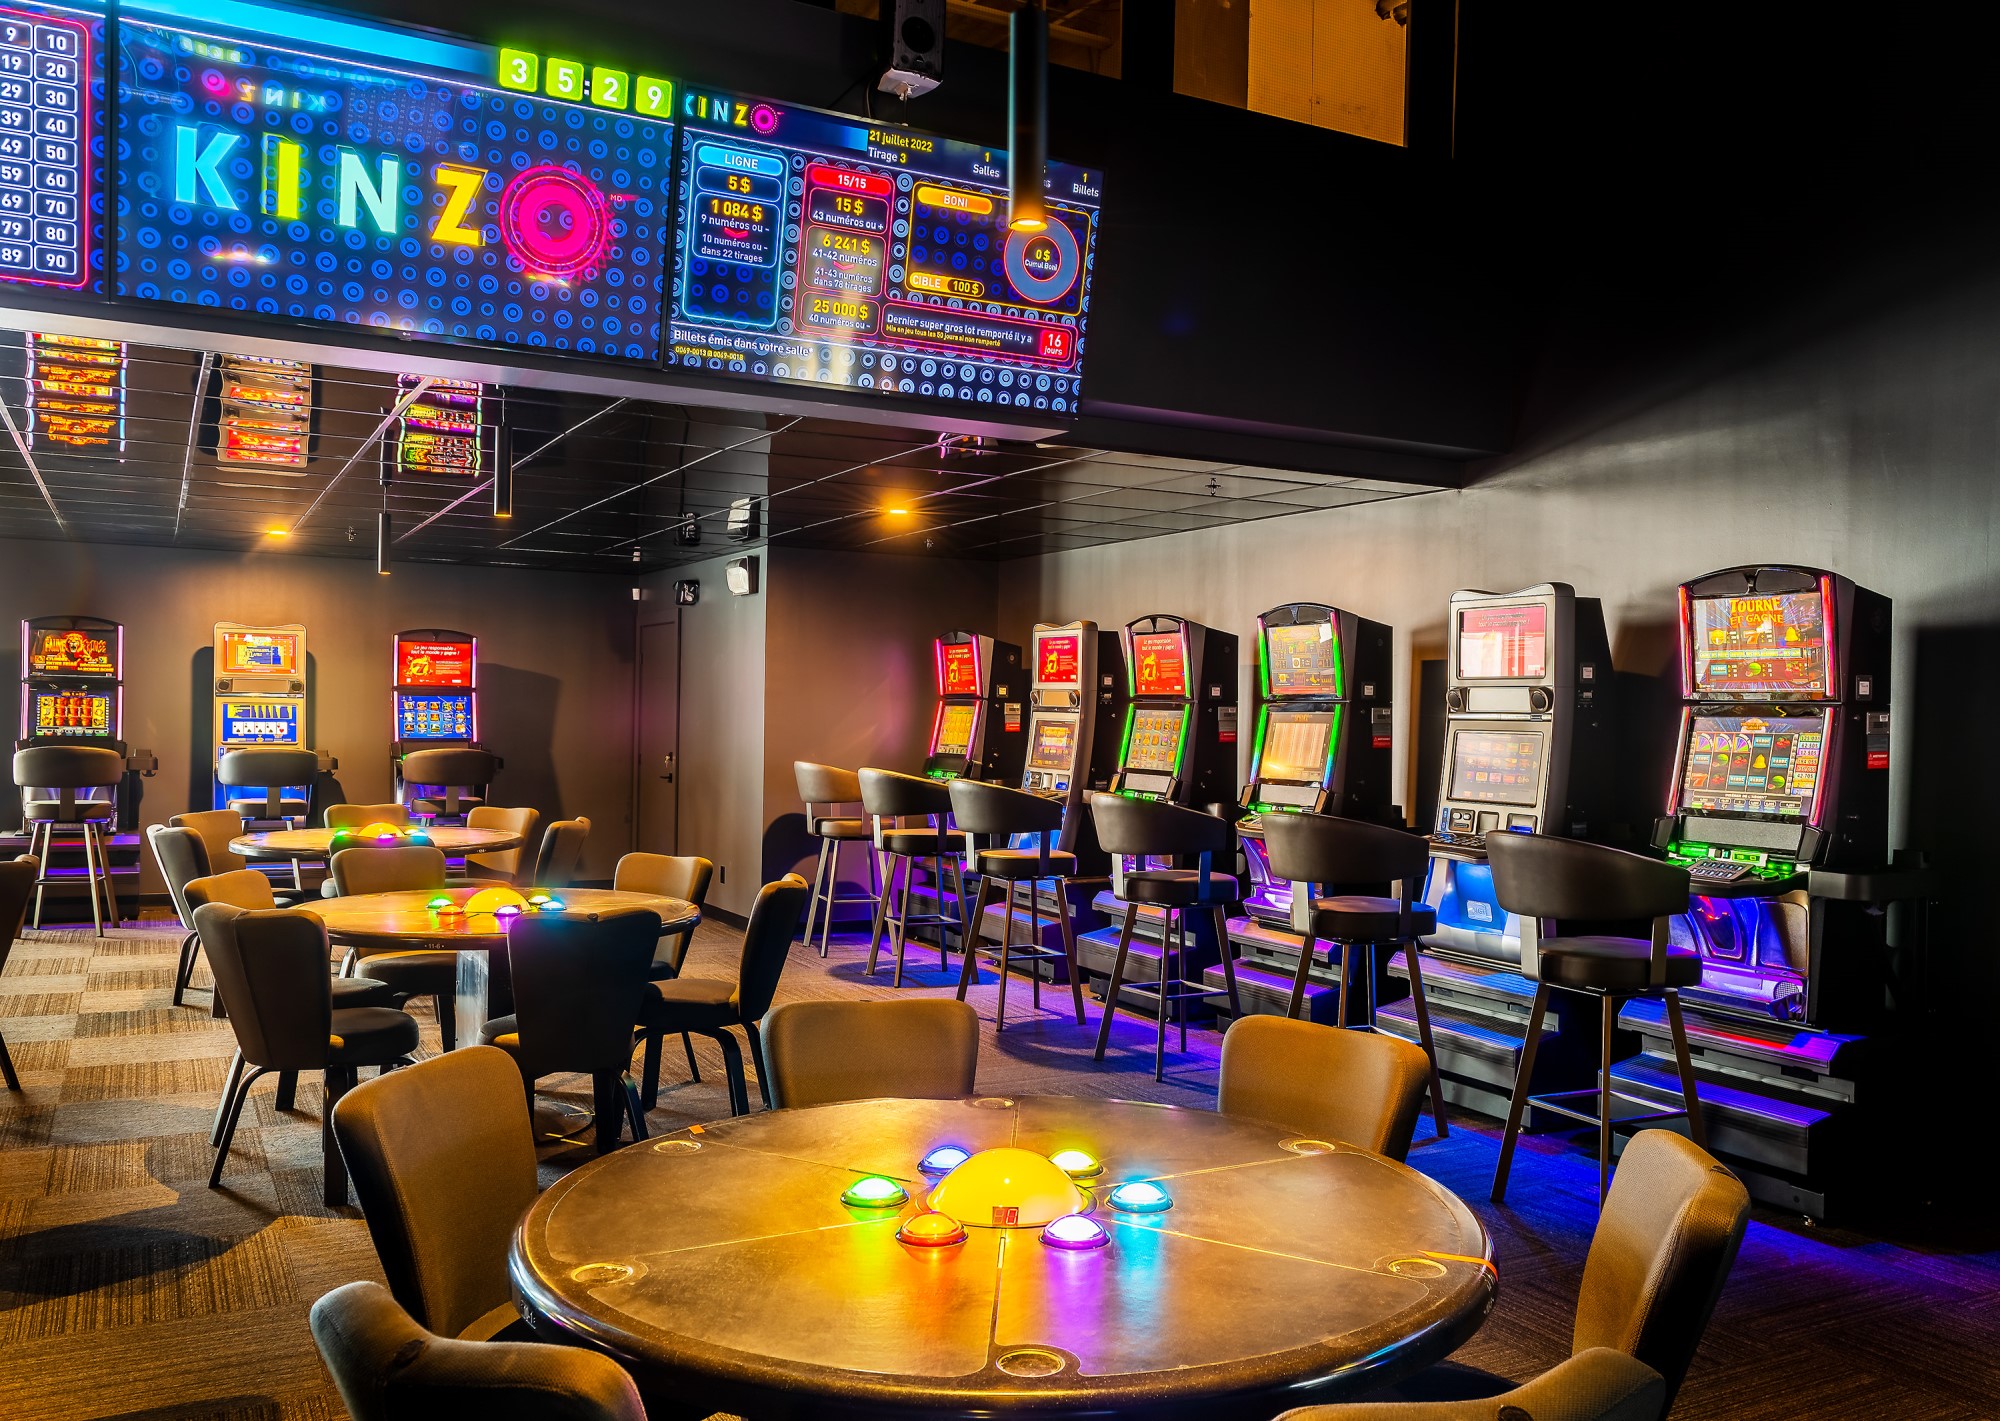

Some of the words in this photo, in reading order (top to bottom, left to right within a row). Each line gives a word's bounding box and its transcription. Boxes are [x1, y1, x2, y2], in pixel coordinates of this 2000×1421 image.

[6, 27, 17, 41] 9
[46, 34, 67, 51] 10
[1, 54, 22, 70] 19
[46, 62, 67, 78] 20
[1, 82, 22, 99] 29
[46, 90, 67, 106] 30
[1, 110, 22, 126] 39
[46, 118, 67, 133] 40
[1, 138, 22, 154] 49
[46, 144, 67, 160] 50
[869, 130, 880, 142] 21
[882, 132, 909, 147] juillet
[910, 139, 933, 153] 2022
[724, 153, 759, 169] LIGNE
[868, 146, 898, 163] Tirage
[900, 153, 907, 163] 3
[985, 152, 990, 163] 1
[1, 165, 22, 181] 59
[46, 173, 67, 188] 60
[973, 164, 1000, 178] Salles
[1083, 173, 1088, 183] 1
[728, 175, 738, 191] 5
[740, 176, 751, 194] $
[838, 174, 867, 189] 15/15
[1072, 183, 1099, 197] Billets
[1, 193, 22, 209] 69
[46, 199, 67, 215] 70
[175, 124, 608, 280] KINZO
[836, 197, 852, 212] 15
[854, 199, 863, 216] $
[943, 194, 968, 208] BONI
[701, 214, 707, 223] 9
[708, 218, 750, 230] numéros
[752, 205, 762, 222] $
[812, 210, 824, 220] 43
[825, 215, 864, 228] numéros
[865, 221, 876, 229] ou
[1, 221, 22, 236] 79
[46, 227, 67, 242] 80
[702, 234, 712, 243] 10
[714, 238, 750, 249] numéros
[752, 243, 762, 251] ou
[860, 239, 870, 255] $
[1, 248, 22, 263] 89
[46, 254, 67, 269] 90
[701, 246, 721, 256] dans
[722, 249, 733, 259] 22
[734, 251, 763, 263] tirages
[812, 248, 838, 260] 41-42
[839, 254, 877, 267] numéros
[1035, 249, 1042, 260] 0
[1044, 250, 1051, 262] $
[1024, 259, 1043, 269] Cumul
[815, 266, 838, 278] 41-43
[839, 272, 873, 283] numéros
[813, 277, 833, 286] dans
[834, 280, 843, 288] 78
[845, 282, 872, 293] tirages
[912, 275, 942, 289] CIBLE
[952, 281, 971, 293] 100
[971, 283, 979, 295] $
[808, 313, 819, 322] 40
[820, 317, 854, 327] numéros
[855, 321, 865, 329] ou
[859, 304, 868, 321] $
[887, 314, 919, 327] Dernier
[919, 319, 944, 330] super
[944, 323, 963, 333] gros
[964, 324, 975, 335] lot
[977, 327, 1013, 340] remporté
[1021, 334, 1026, 343] y
[674, 329, 707, 343] Billets
[708, 334, 733, 347] émis
[734, 338, 758, 351] dans
[759, 343, 784, 354] votre
[1048, 333, 1062, 347] 16
[1043, 346, 1063, 355] jours
[1730, 597, 1783, 613] TOURNE
[1729, 616, 1743, 626] ET
[1746, 613, 1784, 624] GAGNE
